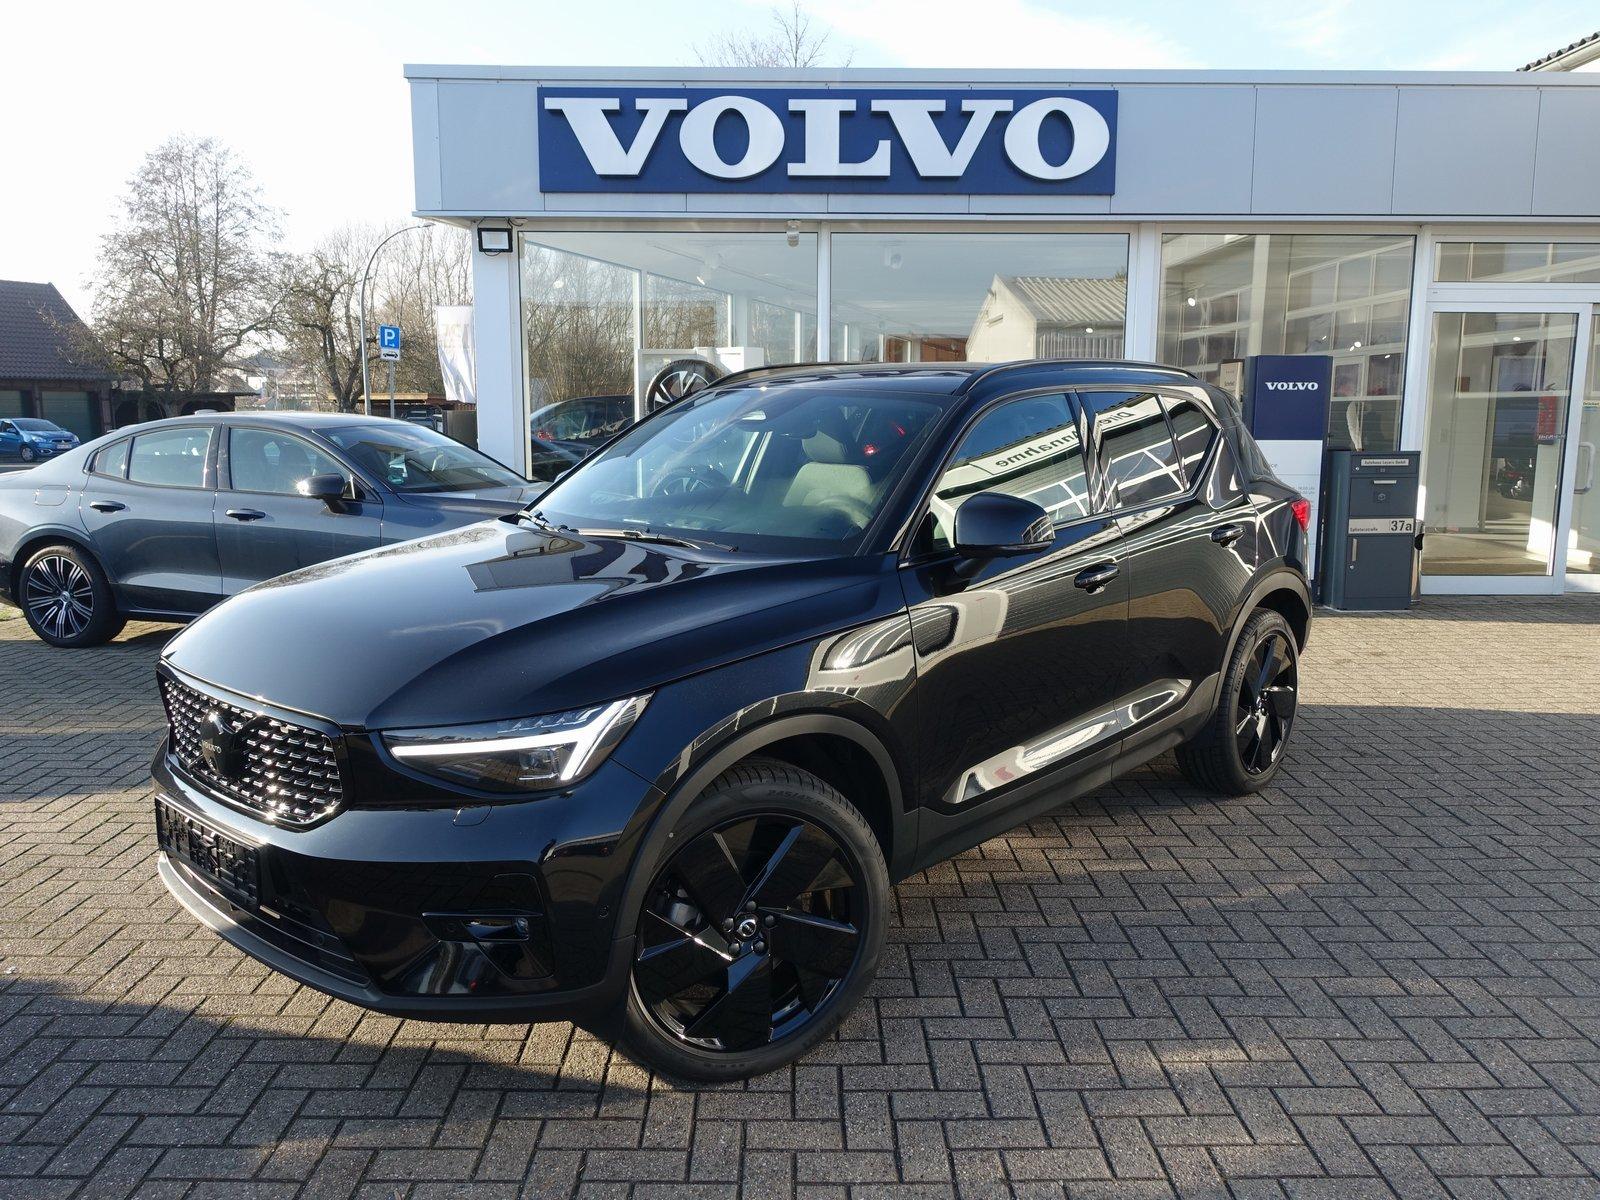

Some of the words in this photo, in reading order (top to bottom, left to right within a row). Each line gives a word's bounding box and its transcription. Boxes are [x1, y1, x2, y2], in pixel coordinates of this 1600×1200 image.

[544, 95, 1110, 180] VOLVO
[385, 329, 395, 346] P
[1265, 381, 1319, 391] VOLVO
[1390, 520, 1412, 532] 37a
